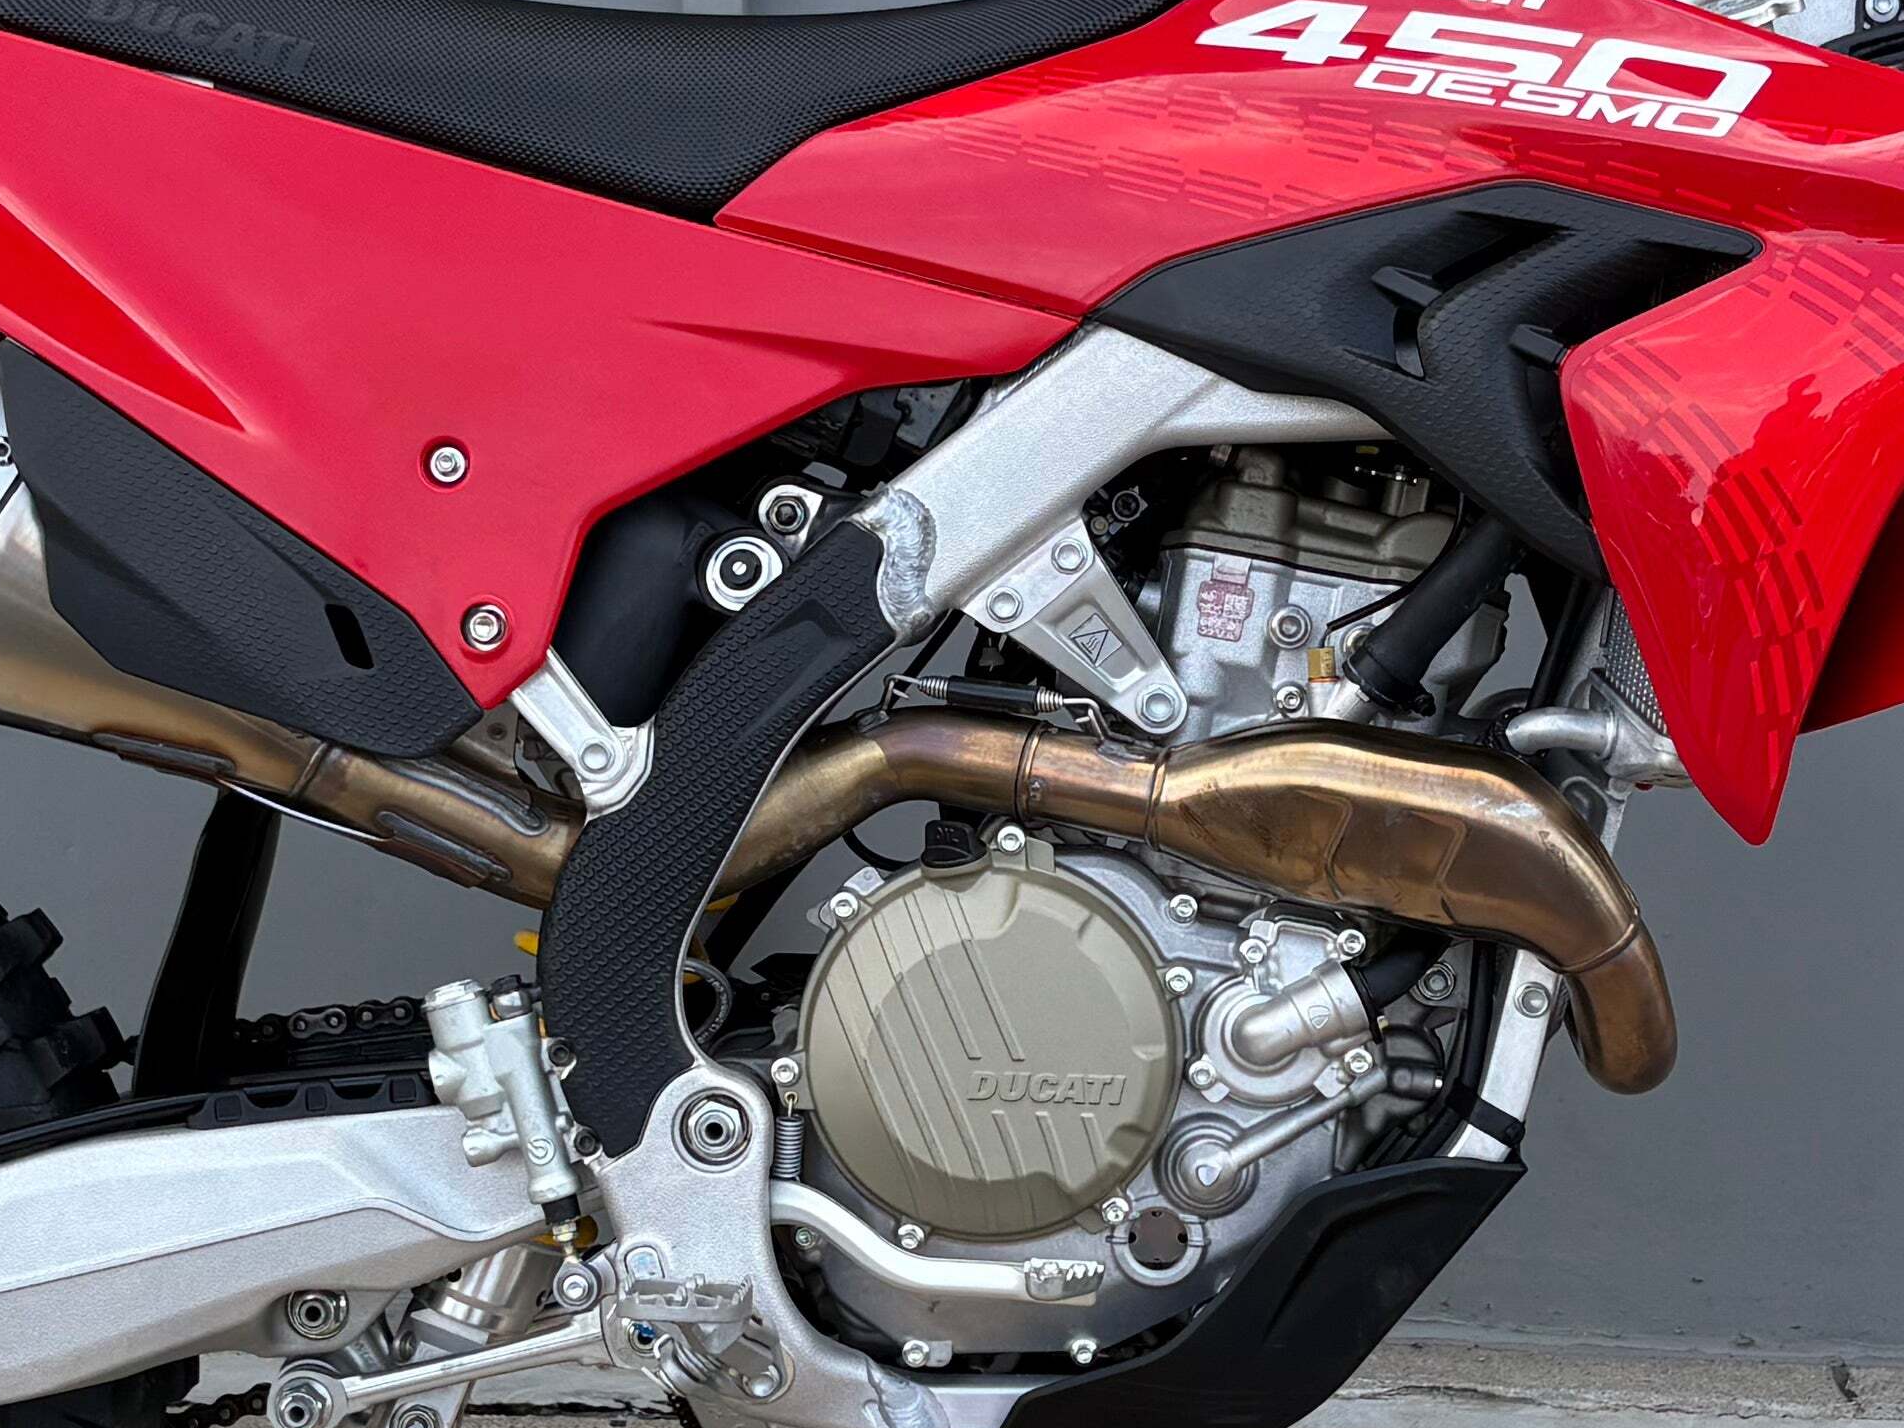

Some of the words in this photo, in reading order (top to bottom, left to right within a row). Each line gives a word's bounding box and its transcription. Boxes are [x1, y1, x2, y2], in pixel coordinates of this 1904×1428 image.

[1195, 0, 1772, 117] 450
[1354, 57, 1740, 138] DESMO
[967, 1073, 1126, 1106] DUCATI
